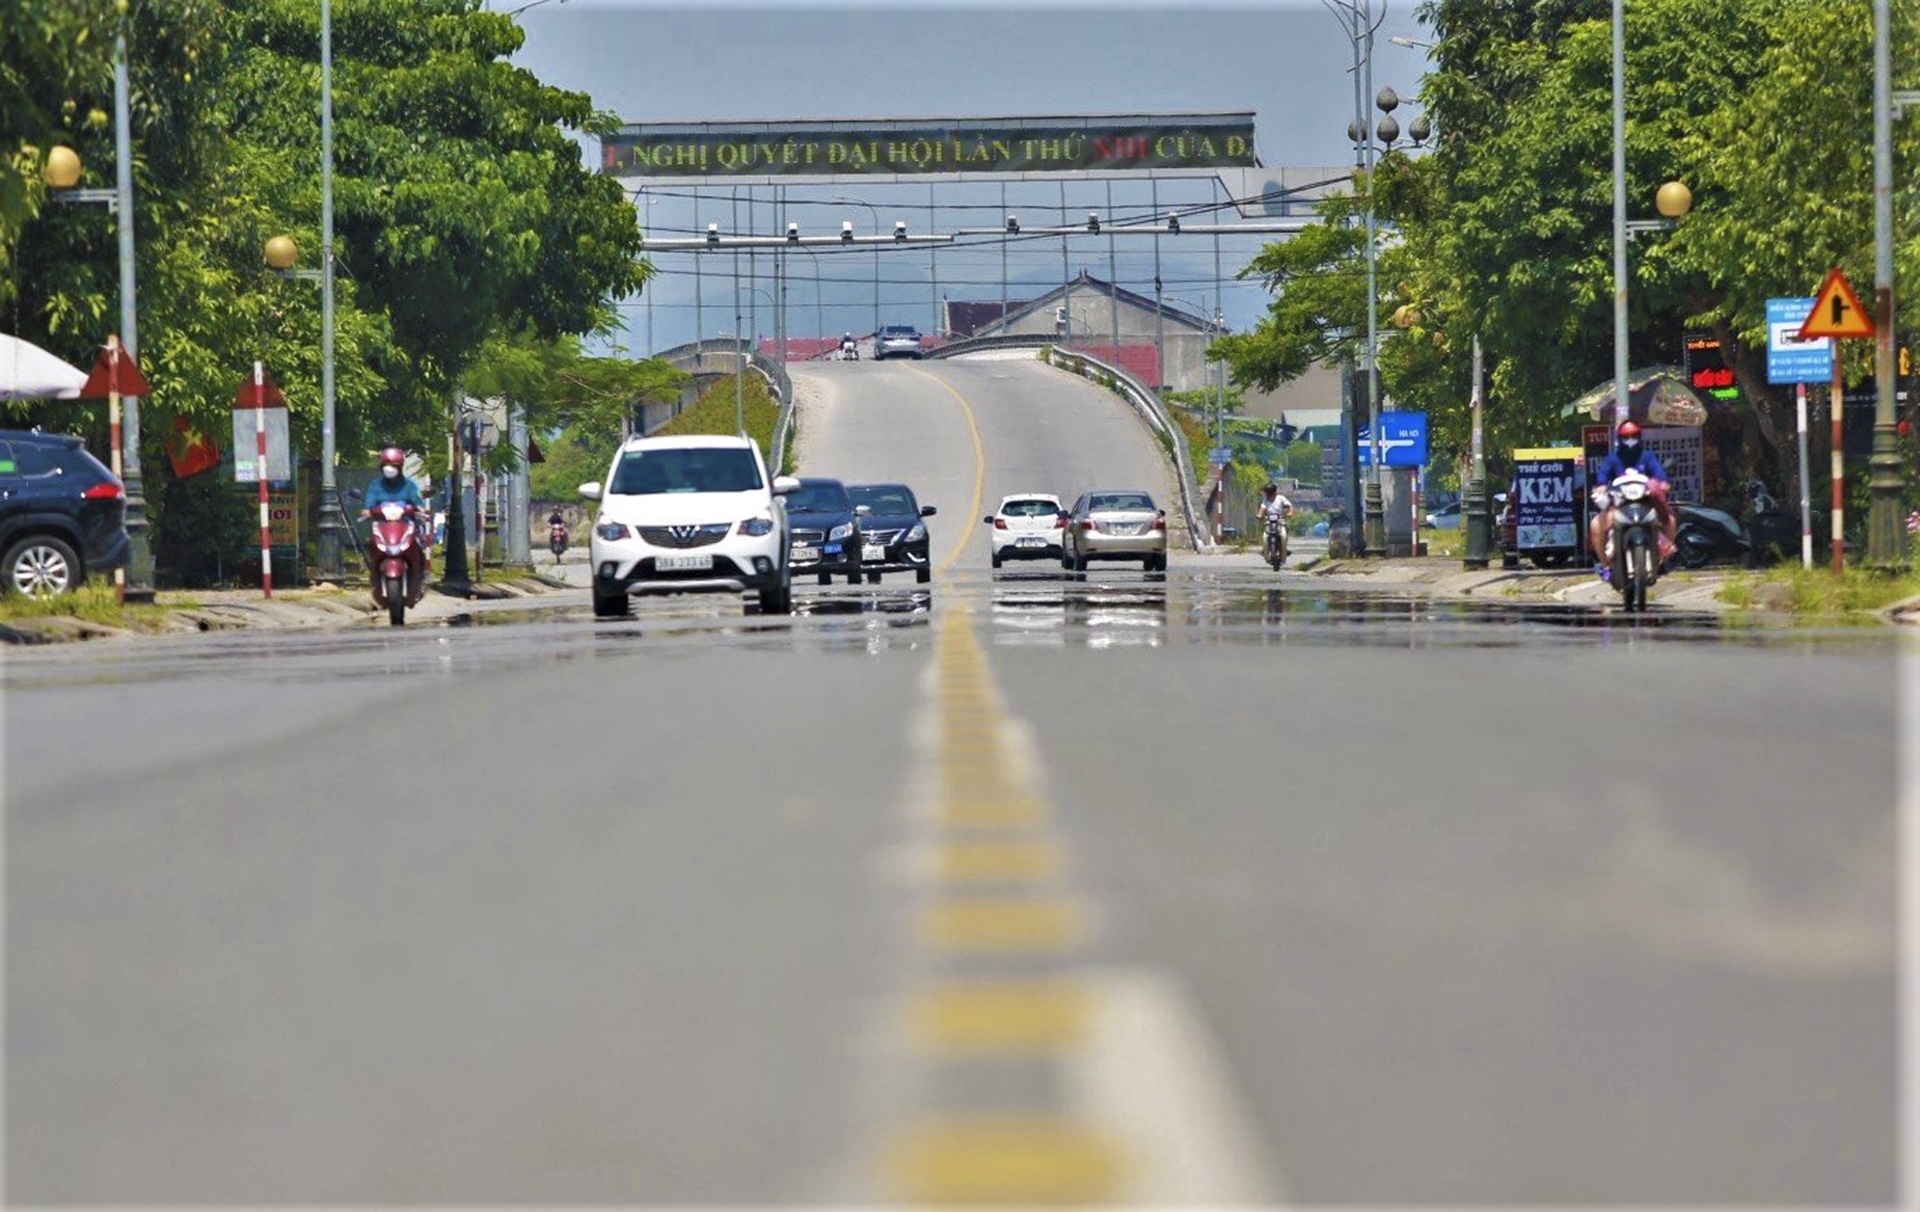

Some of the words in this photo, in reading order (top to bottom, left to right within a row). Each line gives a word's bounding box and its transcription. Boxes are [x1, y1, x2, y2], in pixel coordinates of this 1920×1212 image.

[632, 144, 707, 171] NGHỊ
[716, 136, 819, 170] QUYẾT
[827, 141, 878, 169] ĐẠI
[888, 137, 944, 168] HỘI
[1020, 131, 1087, 161] THỨ
[1091, 136, 1150, 159] XIII
[1155, 130, 1217, 158] CỦA
[1518, 462, 1539, 473] THẾ
[1518, 476, 1574, 504] KEM
